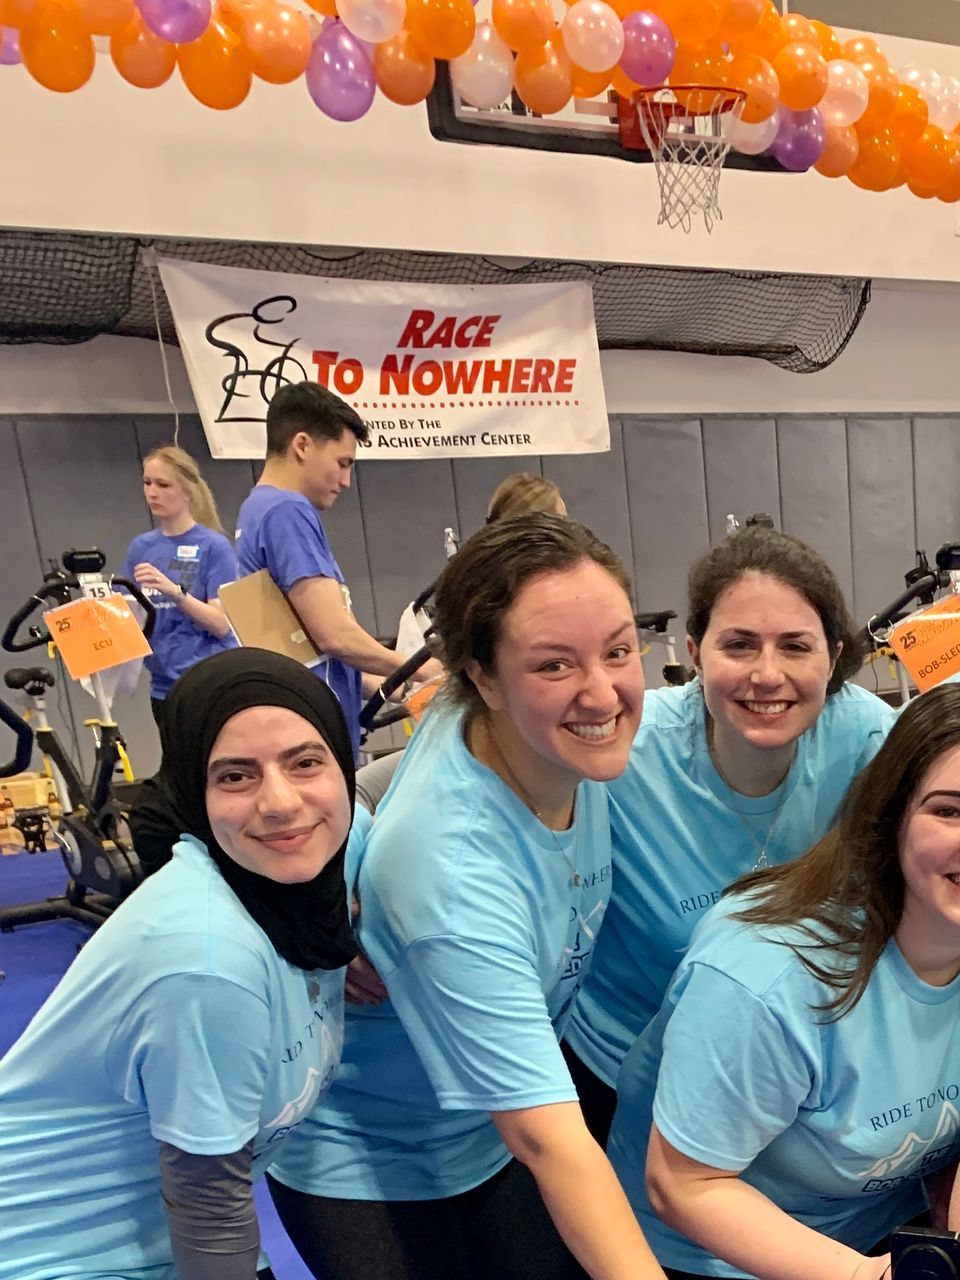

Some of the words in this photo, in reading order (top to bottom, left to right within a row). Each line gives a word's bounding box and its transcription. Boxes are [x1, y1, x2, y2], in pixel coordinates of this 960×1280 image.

[397, 309, 501, 348] RACE
[312, 350, 364, 395] TO
[379, 354, 577, 396] NOWHERE
[378, 433, 477, 448] ACHIEVEMENT
[481, 431, 532, 446] CENTER
[89, 587, 106, 599] 15
[56, 616, 71, 632] 25
[93, 639, 113, 651] ECU
[900, 630, 917, 650] 25
[869, 1103, 913, 1132] RIDE
[916, 1093, 936, 1113] TO
